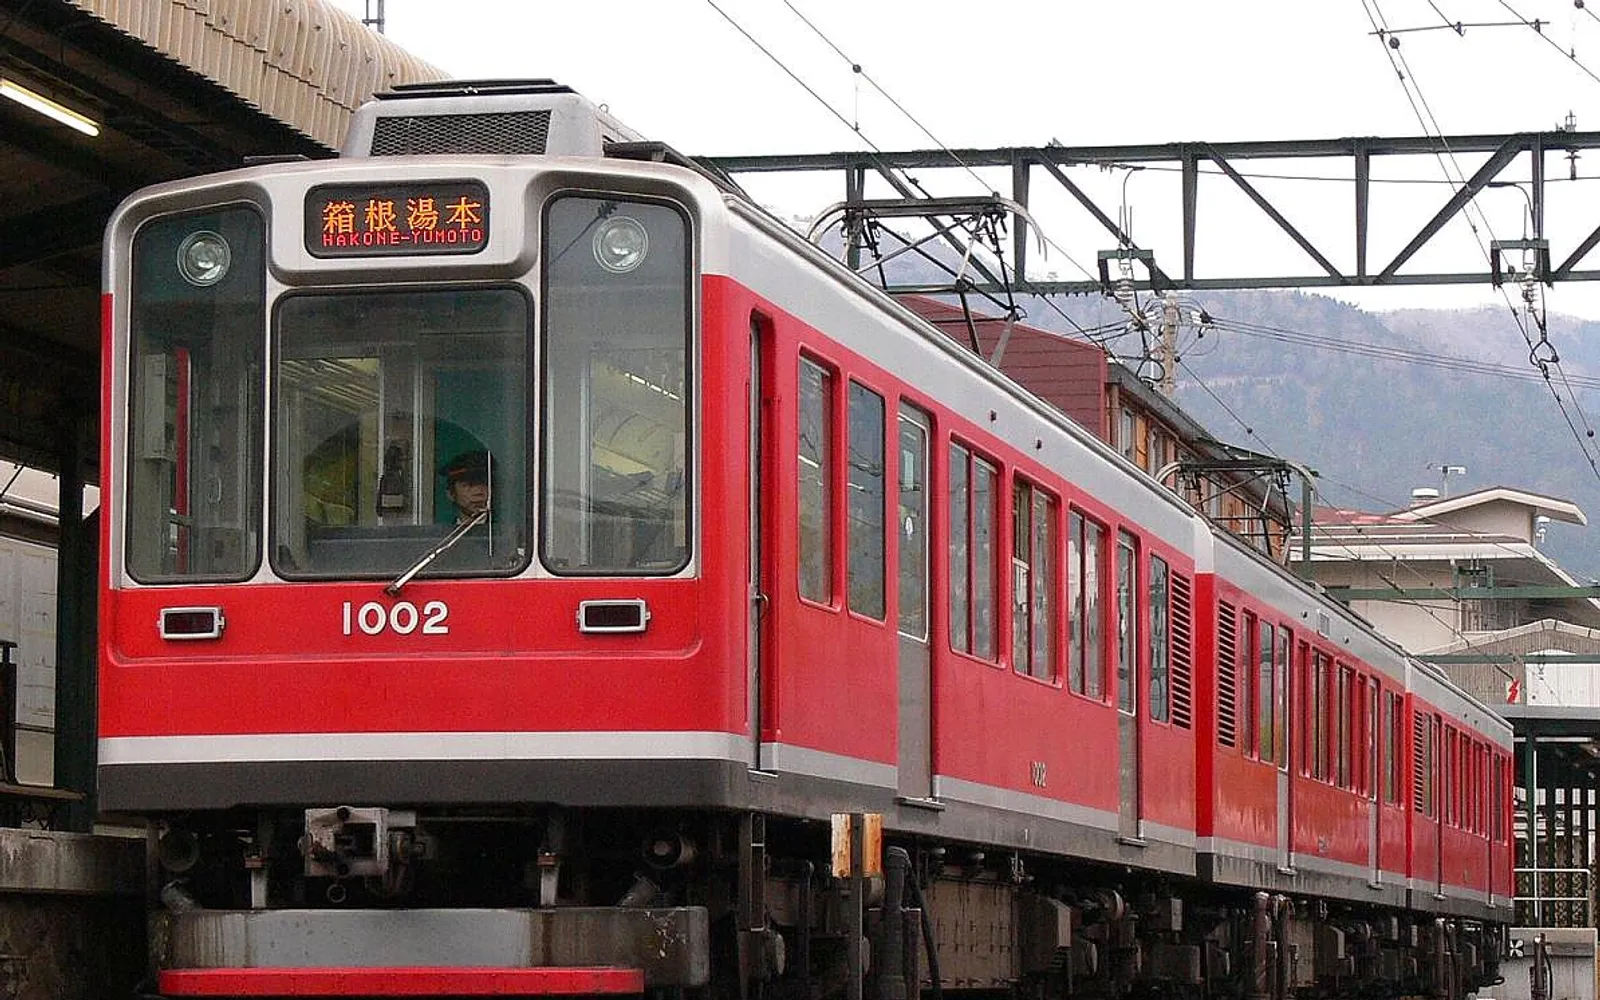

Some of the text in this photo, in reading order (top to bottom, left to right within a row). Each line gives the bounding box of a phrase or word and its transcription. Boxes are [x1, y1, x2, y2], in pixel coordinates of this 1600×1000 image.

[322, 196, 481, 234] 箱根湯本
[322, 229, 483, 247] HAKONE-YUMOTO
[343, 601, 449, 635] 1002
